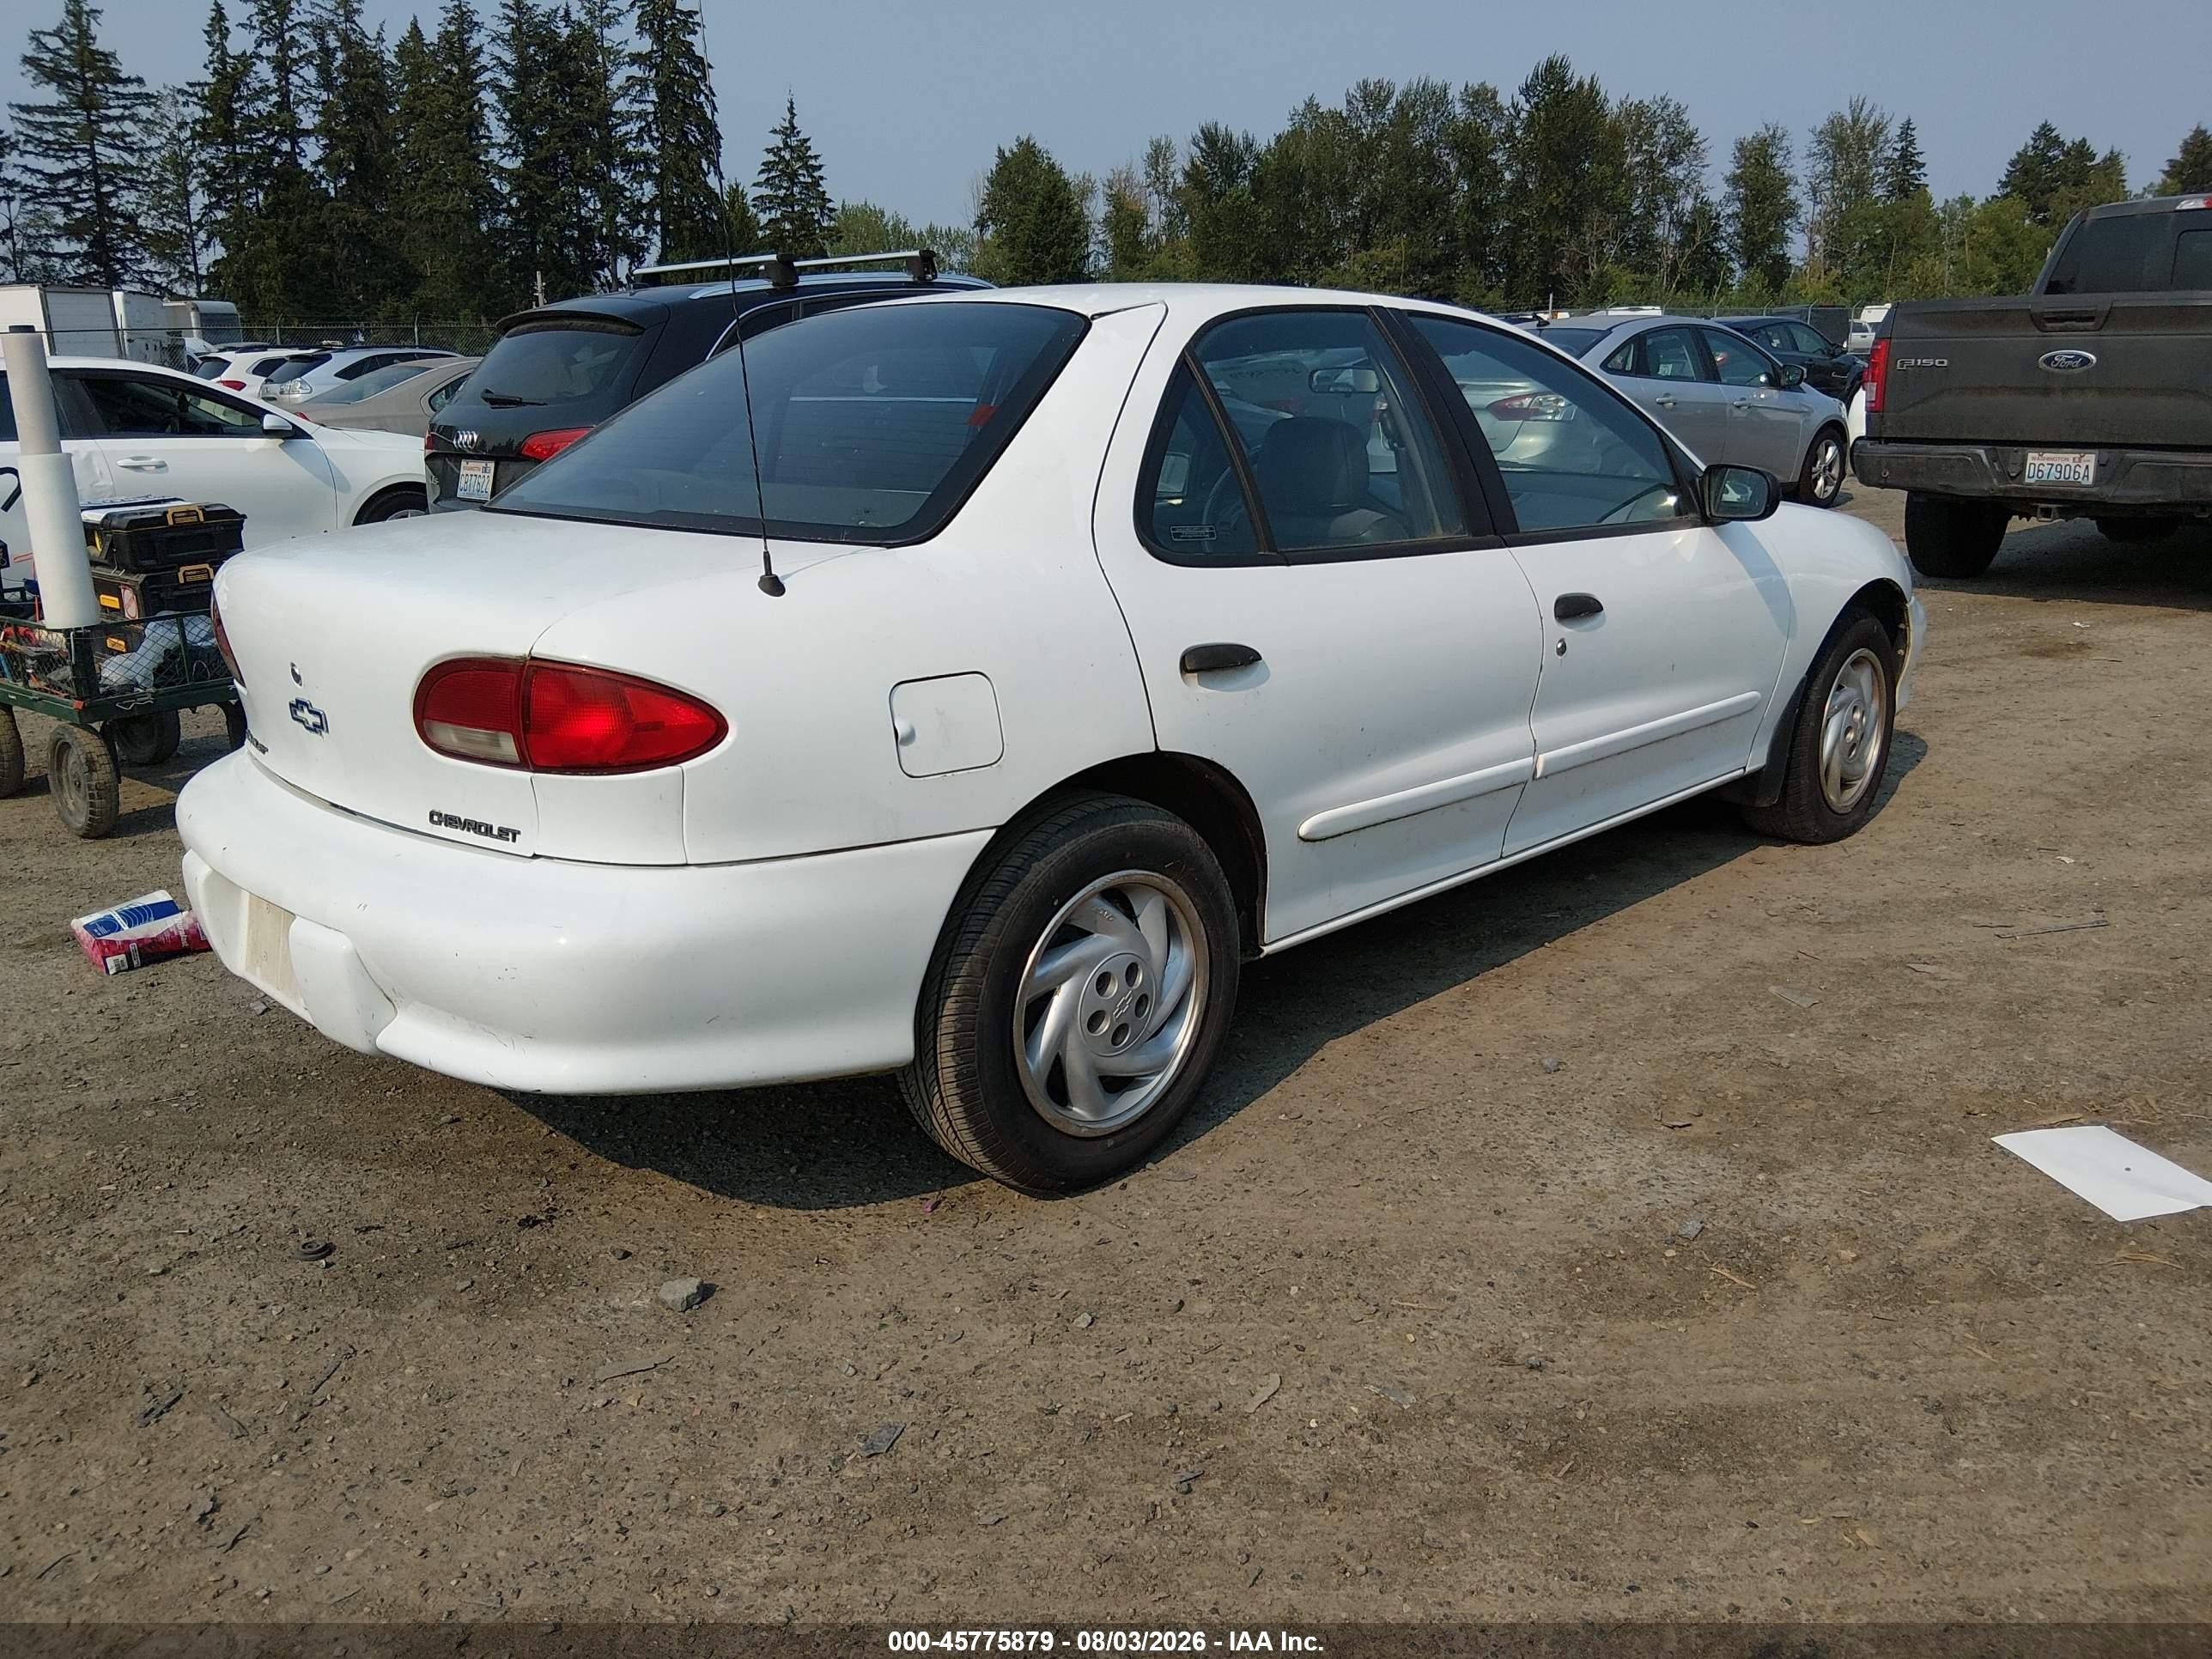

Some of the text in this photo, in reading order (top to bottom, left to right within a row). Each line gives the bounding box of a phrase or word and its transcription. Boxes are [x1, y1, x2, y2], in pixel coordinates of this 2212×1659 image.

[2051, 355, 2081, 368] Ford
[2027, 463, 2089, 481] D67906A
[428, 809, 521, 843] CHEVROLET
